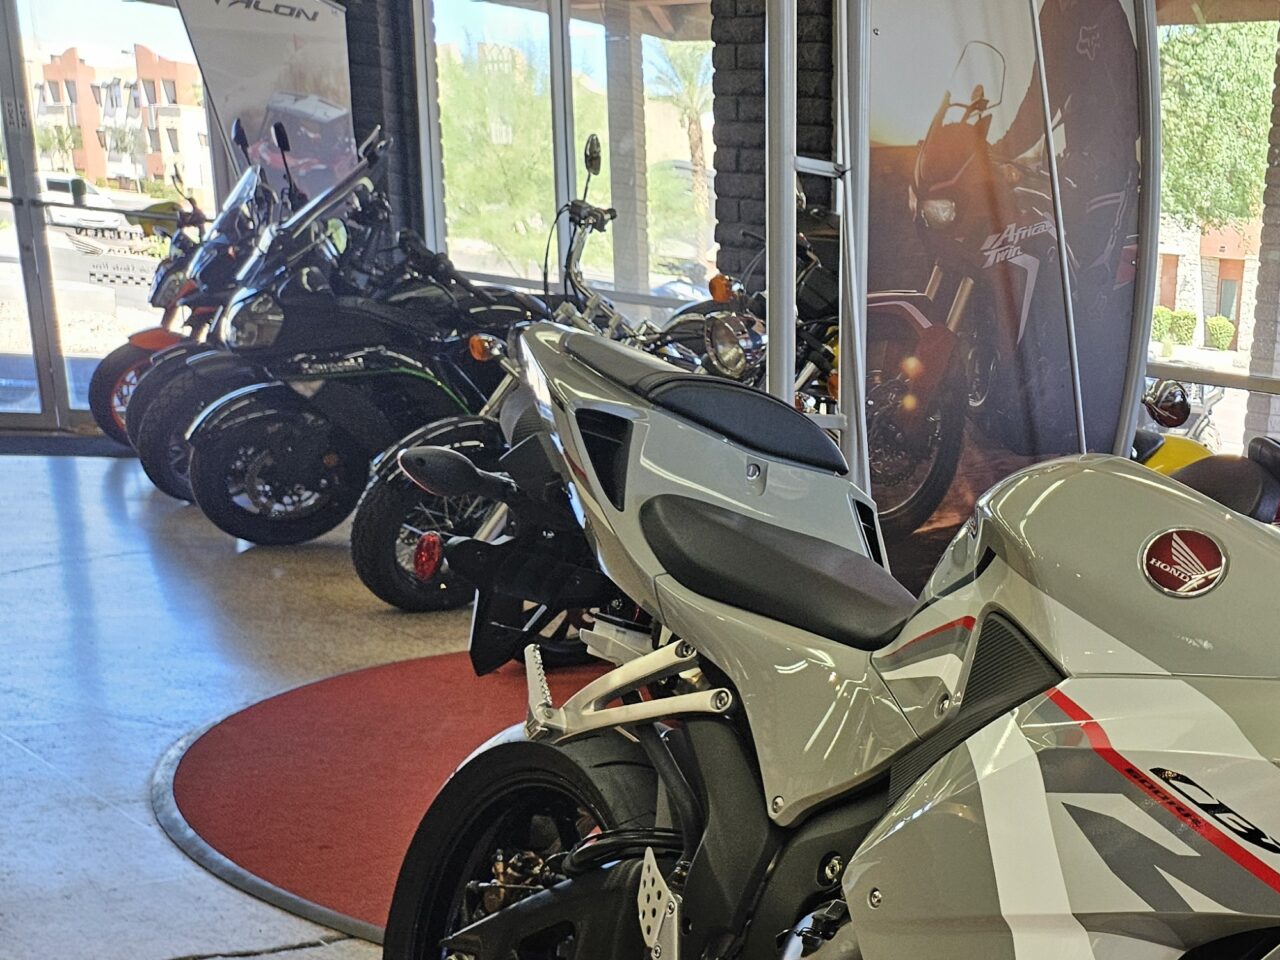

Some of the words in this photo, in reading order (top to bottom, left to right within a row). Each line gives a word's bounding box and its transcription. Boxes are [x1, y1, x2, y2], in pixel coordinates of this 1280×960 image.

[991, 222, 1047, 249] Africa
[982, 245, 1023, 269] Twin
[1149, 557, 1196, 586] HOND
